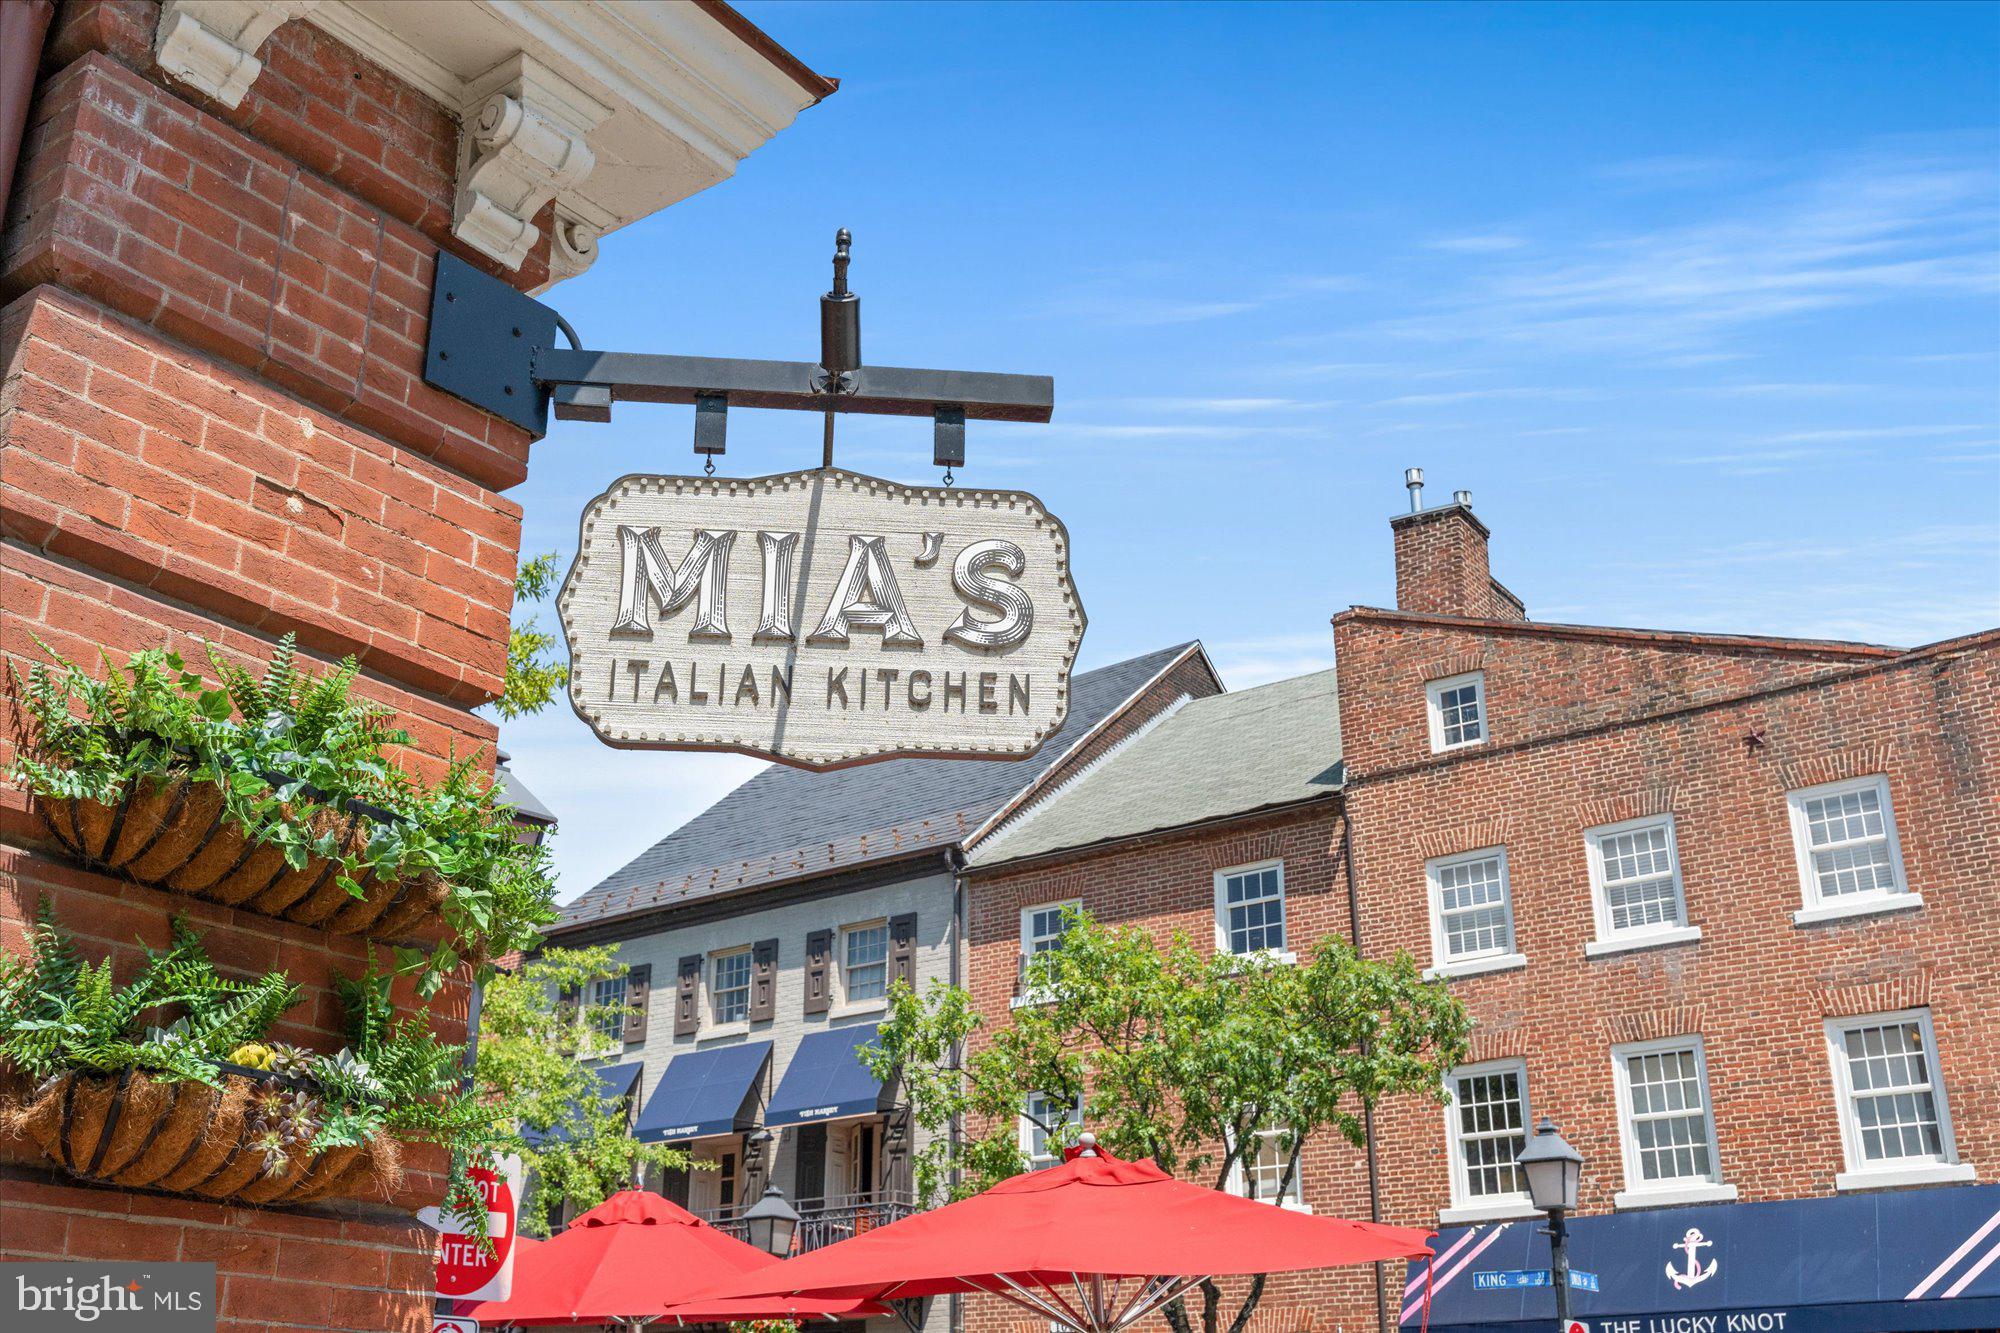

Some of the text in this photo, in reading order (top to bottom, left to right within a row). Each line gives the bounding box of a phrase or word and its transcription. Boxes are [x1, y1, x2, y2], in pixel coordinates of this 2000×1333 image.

[610, 525, 1034, 649] MIA'S
[609, 658, 1031, 716] ITALIAN KITCHEN
[440, 1243, 487, 1268] NTER
[1478, 1273, 1507, 1287] KING
[1650, 1315, 1717, 1333] LUCKY
[1727, 1313, 1787, 1332] KNOT
